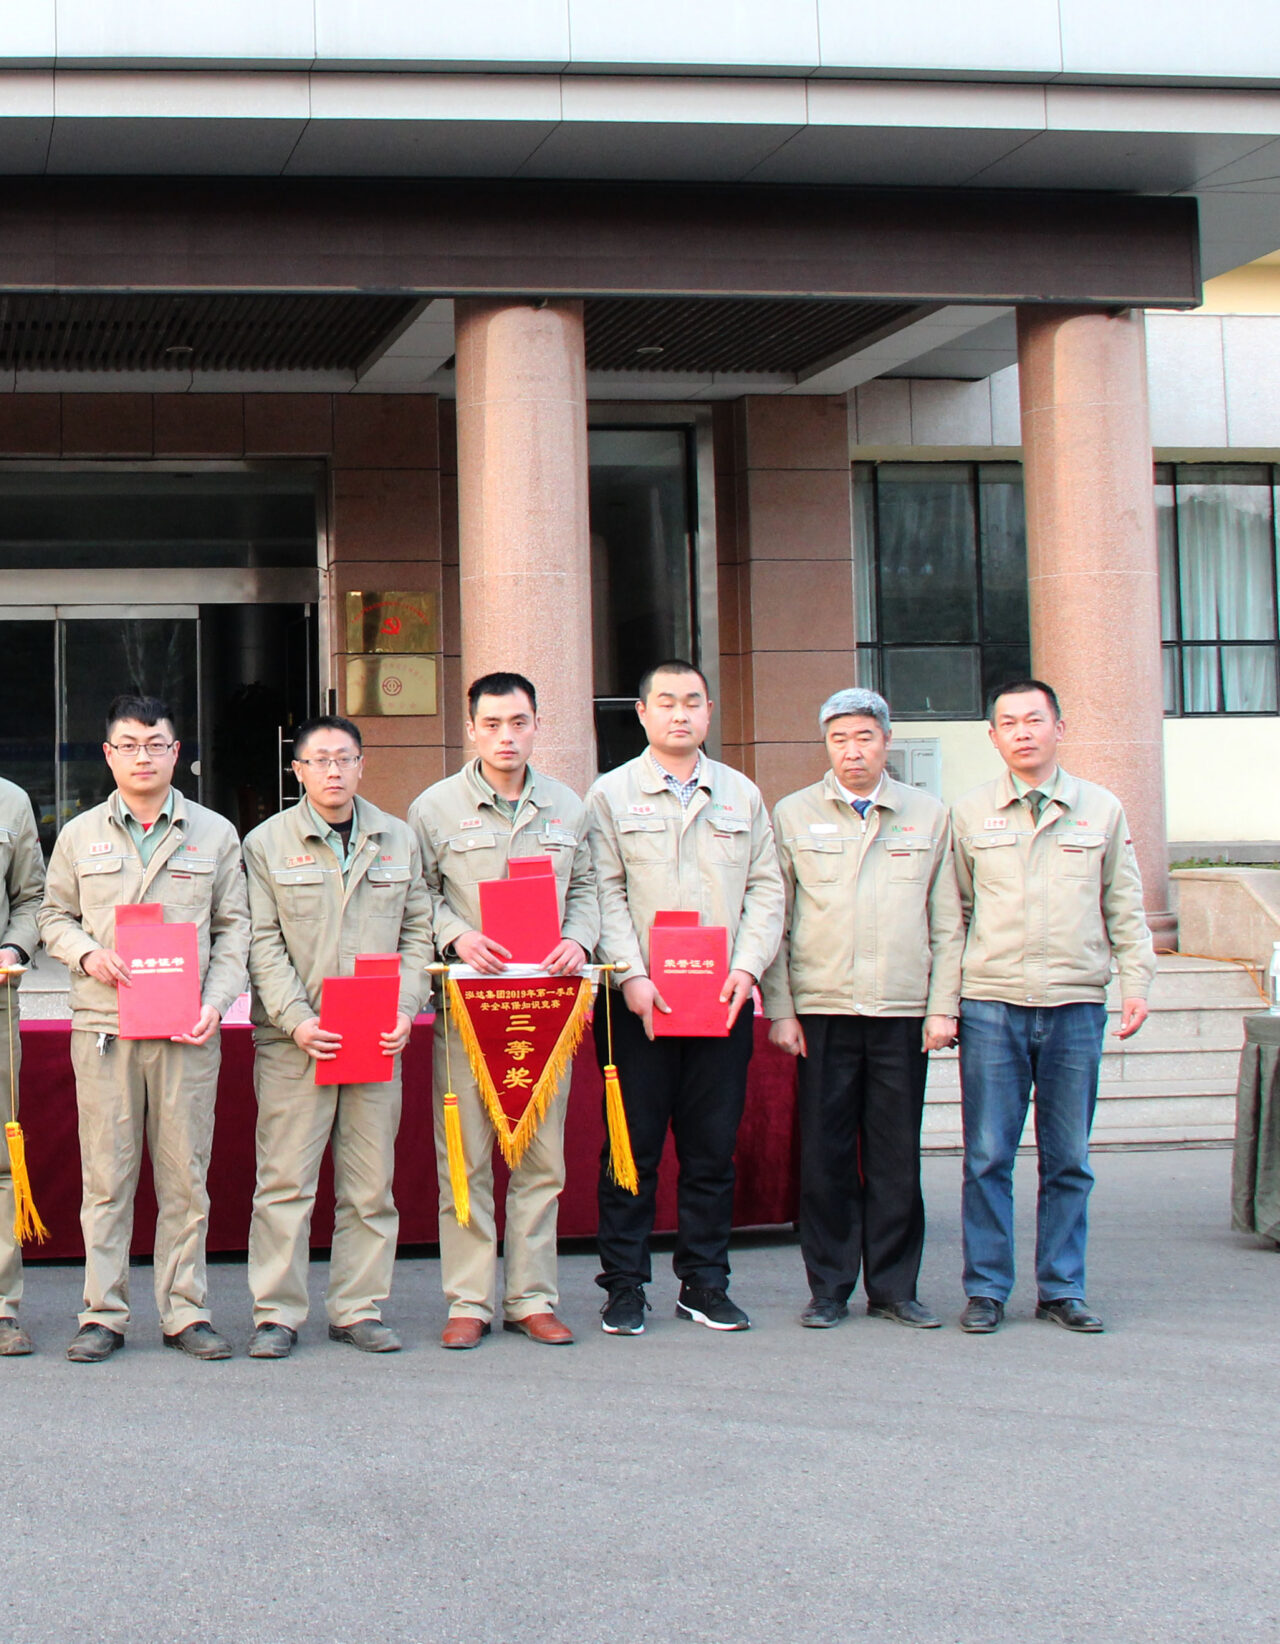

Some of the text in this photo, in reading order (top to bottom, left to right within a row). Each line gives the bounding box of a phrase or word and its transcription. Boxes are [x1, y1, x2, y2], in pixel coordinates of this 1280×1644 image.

[664, 959, 715, 968] 荣誉证书
[480, 999, 561, 1012] 安全环保知识竞赛
[503, 1013, 537, 1089] 三等奖
